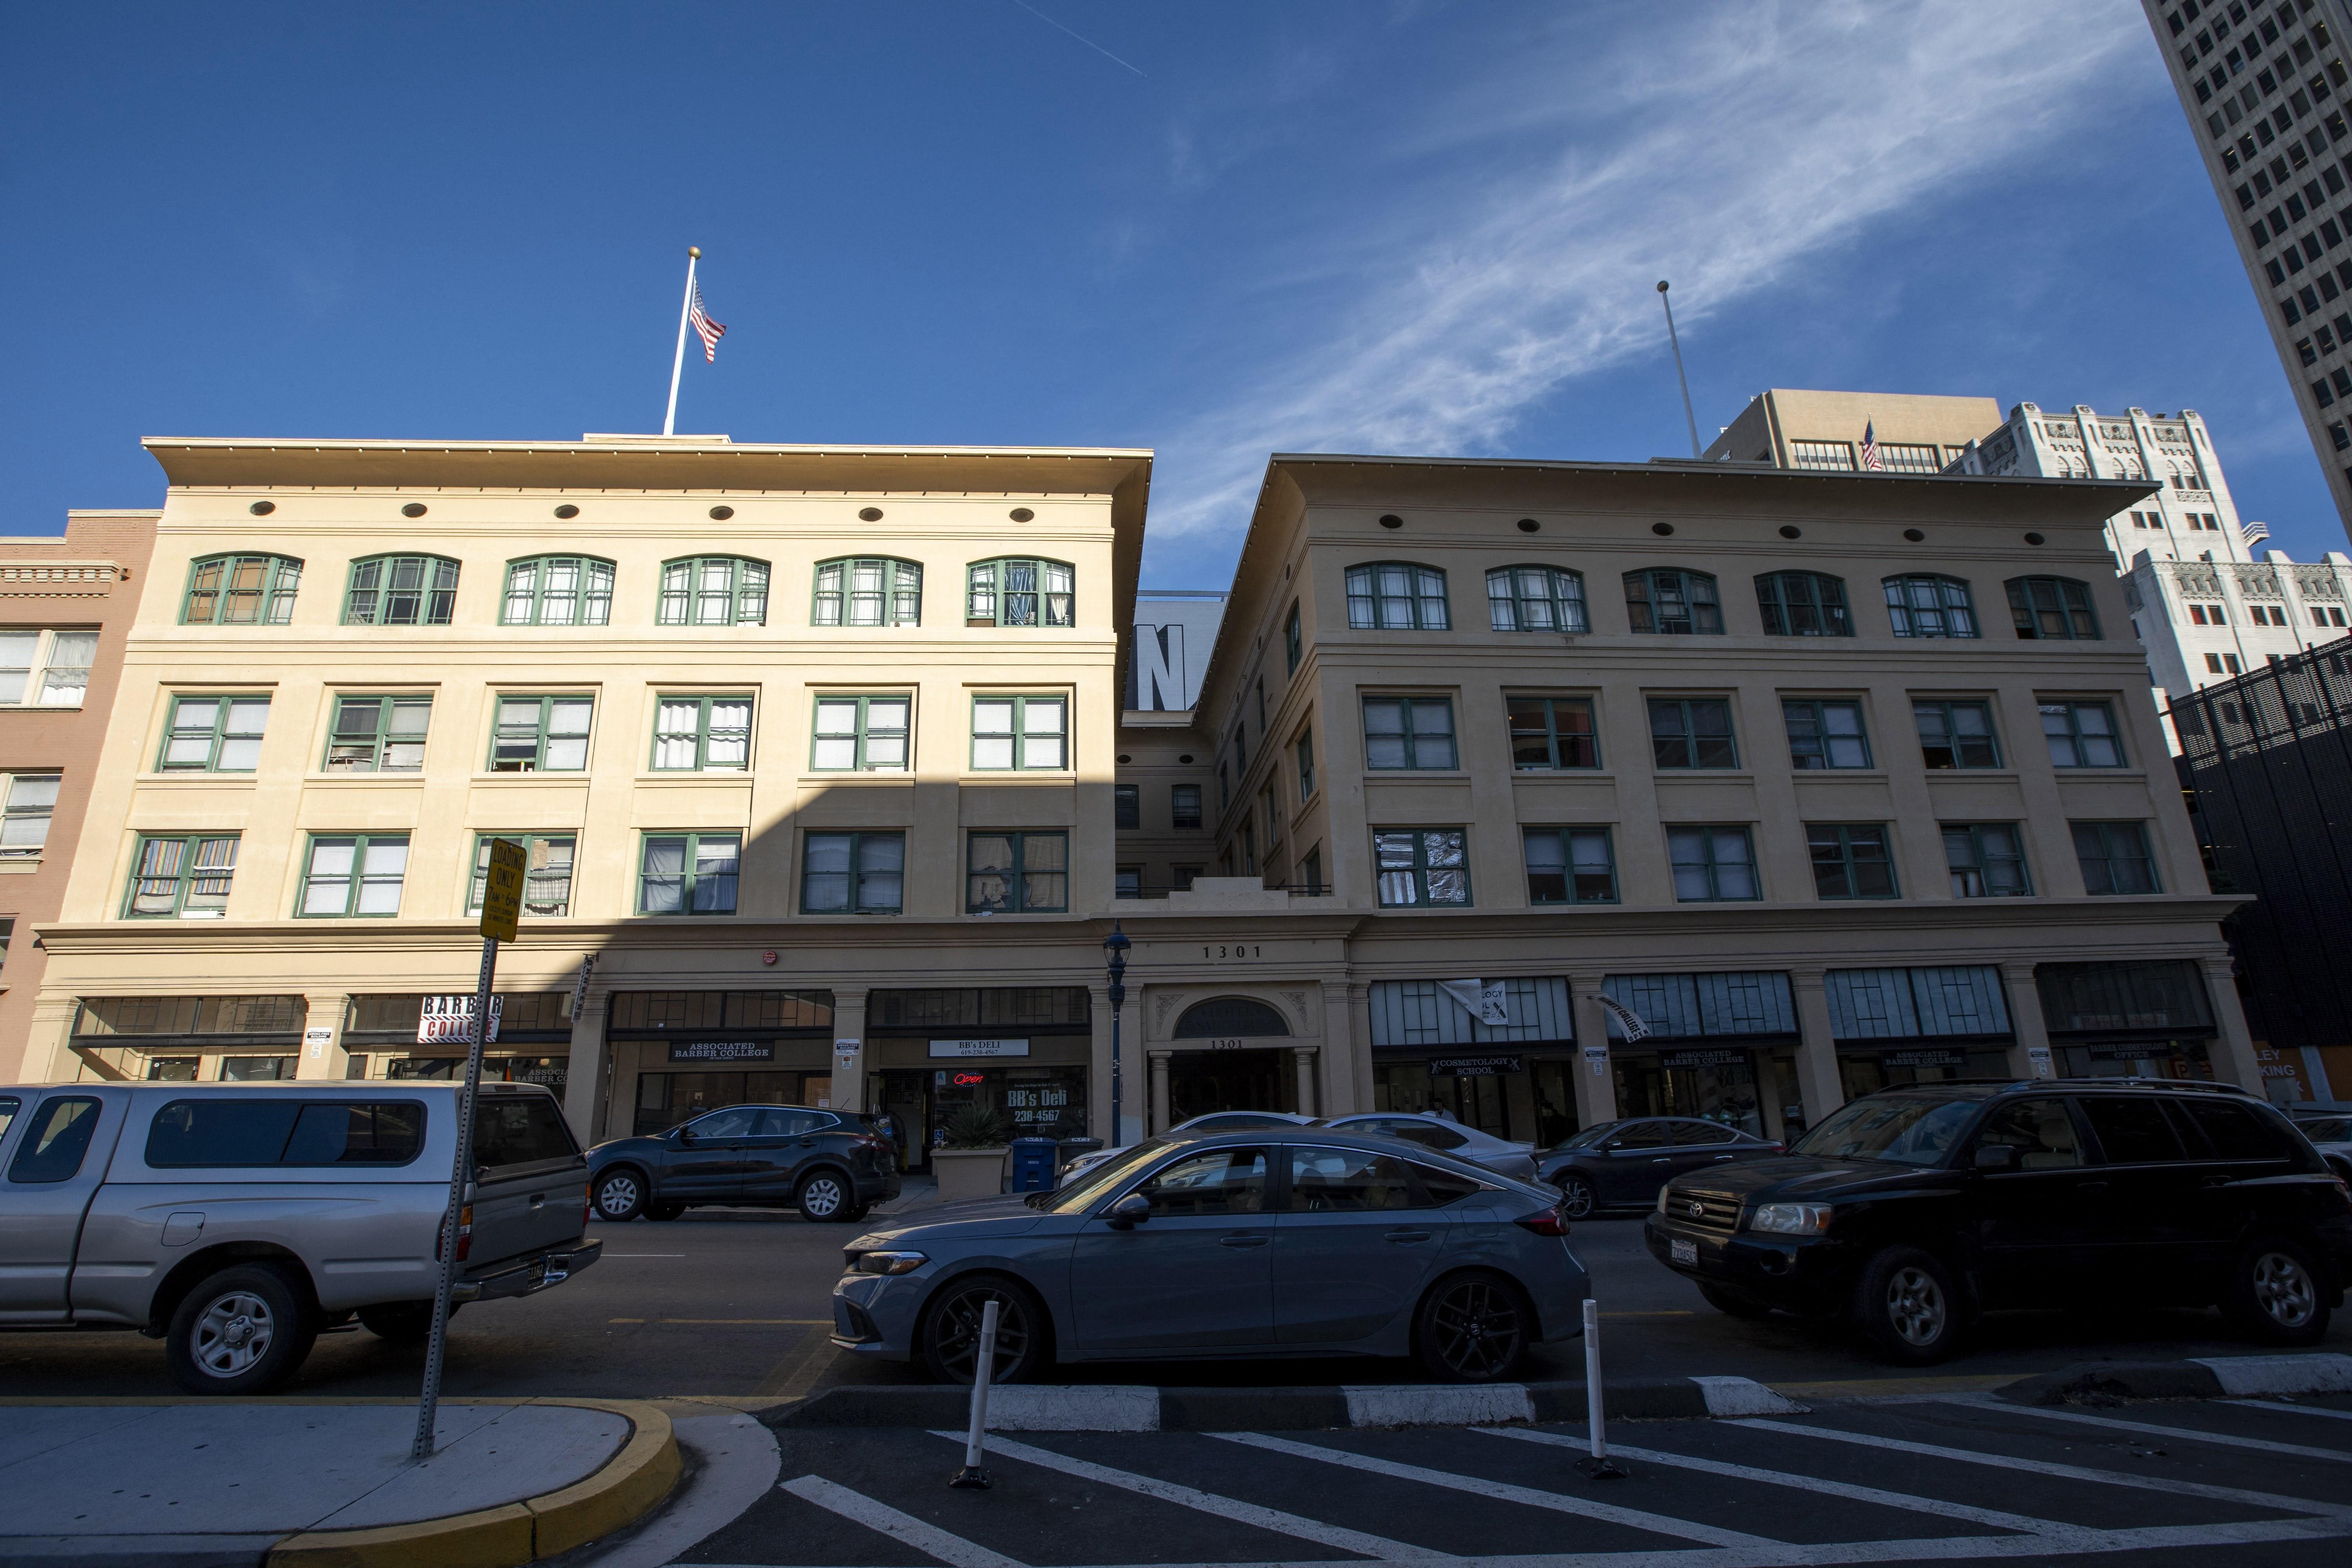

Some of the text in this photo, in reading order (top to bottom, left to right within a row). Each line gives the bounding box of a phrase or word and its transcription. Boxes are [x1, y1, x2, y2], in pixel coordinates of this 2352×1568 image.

[493, 845, 524, 871] LOADING
[496, 867, 516, 889] ONLY
[488, 886, 499, 904] 7AM
[505, 892, 518, 907] 6PM
[1203, 946, 1260, 958] 1301
[424, 996, 502, 1014] BARBR
[1597, 997, 1641, 1034] BEAUTY COLLEGE
[428, 1021, 493, 1036] COLLEE
[1628, 1029, 1649, 1042] OPEN
[1211, 1040, 1243, 1049] 1301
[2118, 1042, 2167, 1051] COSMETOLOGY
[1440, 1058, 1508, 1067] COSMETOLOGY
[1702, 1056, 1744, 1064] COLLEGE
[954, 1073, 984, 1085] Open
[1008, 1089, 1067, 1107] BB's Deli
[1014, 1110, 1060, 1122] 238-4567
